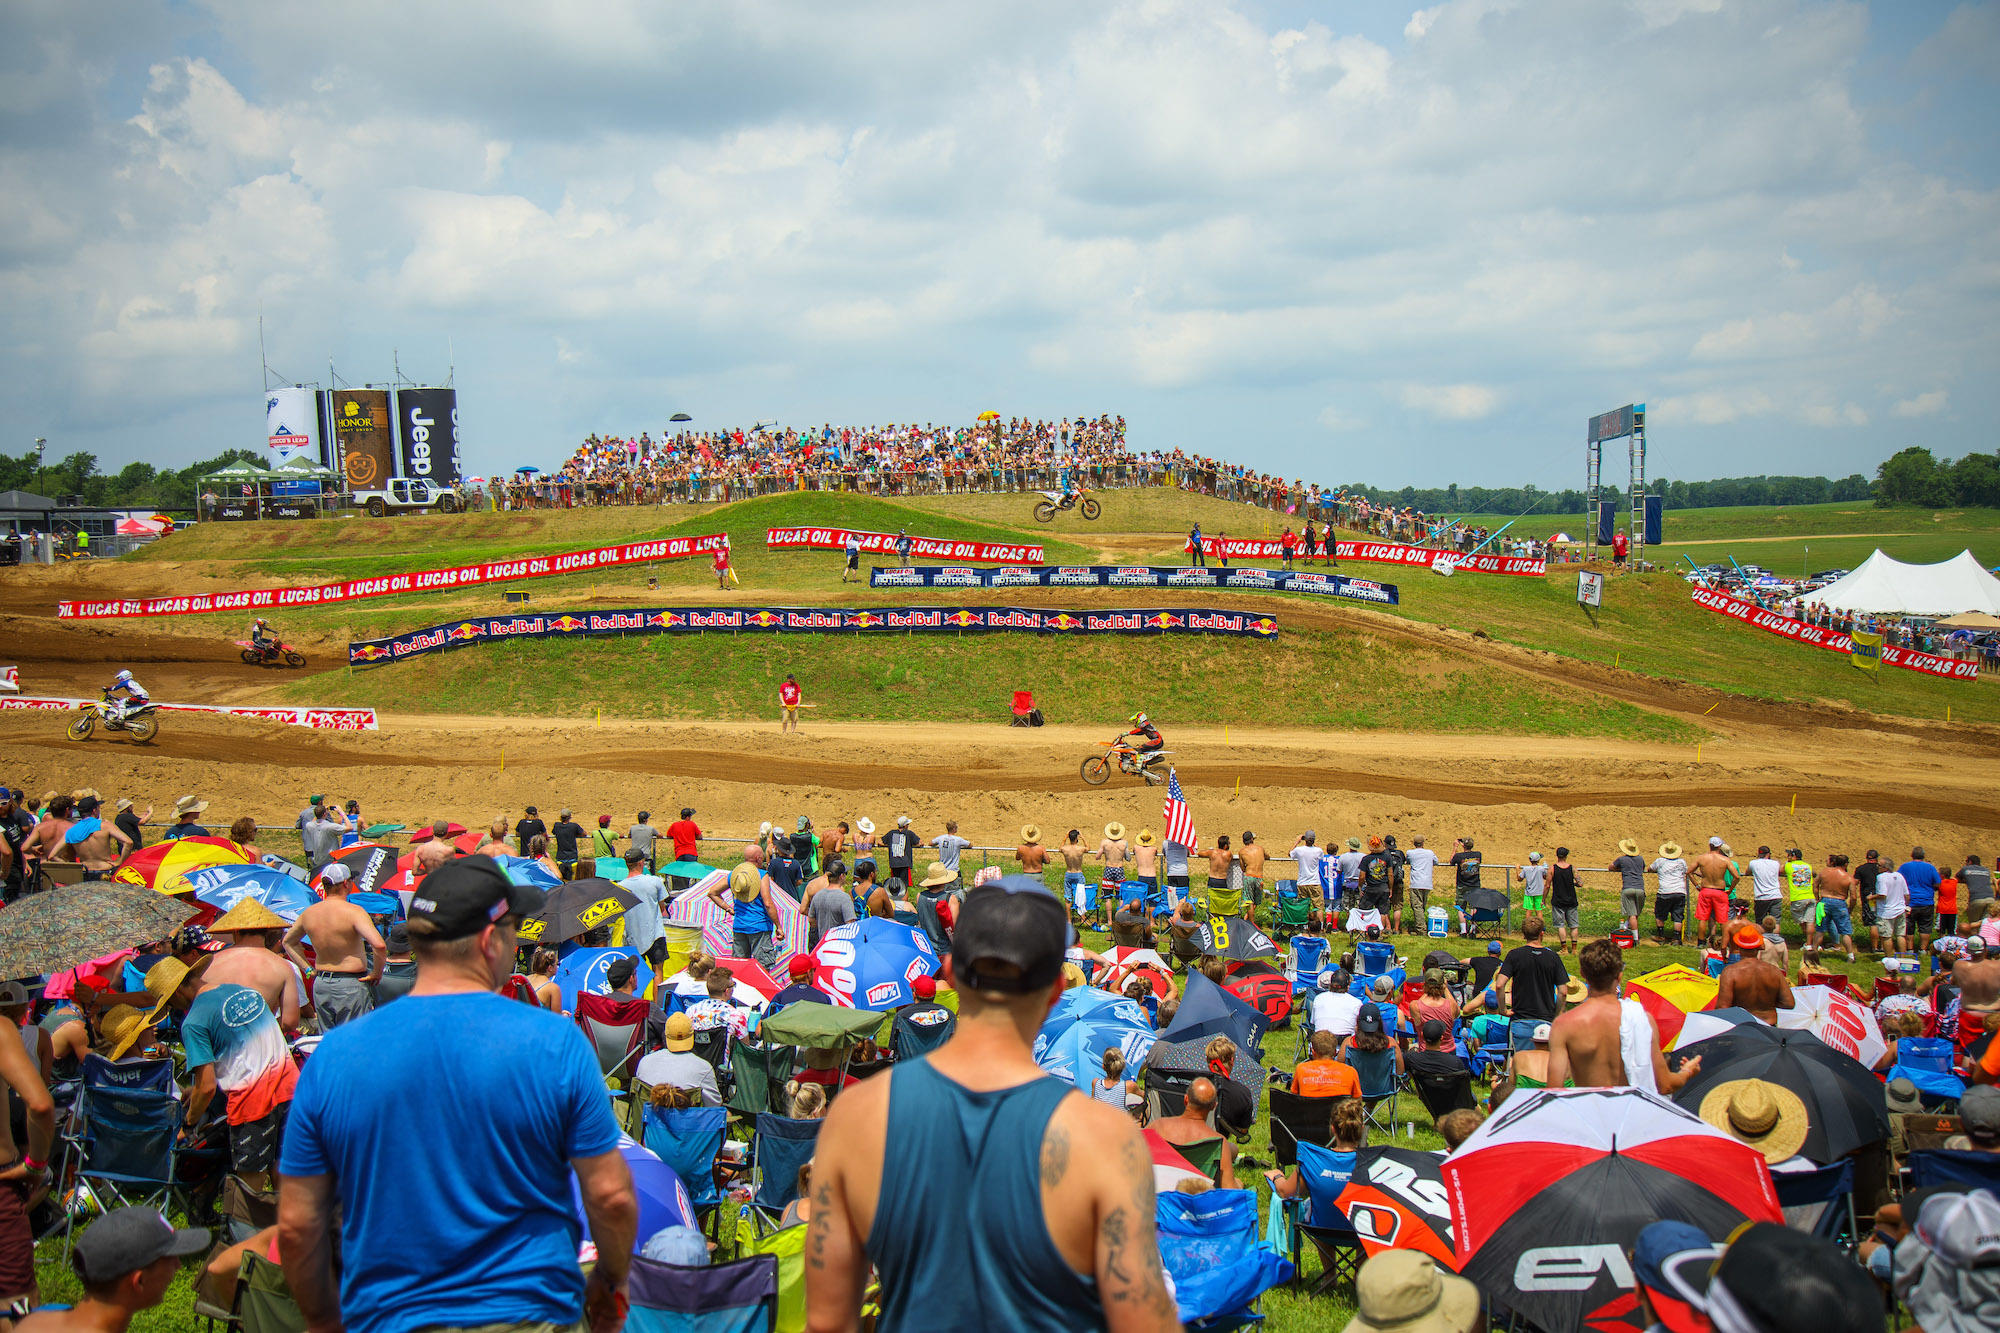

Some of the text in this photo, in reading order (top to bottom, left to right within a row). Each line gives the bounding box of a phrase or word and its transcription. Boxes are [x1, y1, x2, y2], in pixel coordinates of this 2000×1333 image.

[338, 418, 373, 428] HONOR
[411, 408, 435, 476] Jeep
[222, 508, 244, 518] Jeep
[279, 508, 300, 517] Jeep
[767, 529, 809, 544] LUCAS
[811, 529, 832, 544] OIL
[955, 543, 976, 558] OIL
[981, 546, 1025, 562] LUCAS
[1336, 544, 1356, 557] OIL
[1361, 545, 1404, 561] LUCAS
[1406, 549, 1427, 563] OIL
[1478, 558, 1499, 571] OIL
[1505, 560, 1545, 574] LUCAS
[79, 602, 120, 617] LUCAS
[122, 602, 143, 614] OIL
[148, 599, 190, 613] LUCAS
[192, 597, 213, 610] OIL
[252, 592, 274, 605] OIL
[279, 588, 321, 604] LUCAS
[324, 585, 344, 599] OIL
[349, 579, 389, 597] LUCAS
[391, 576, 412, 590] OIL
[416, 570, 457, 588] LUCAS
[460, 568, 481, 582] OIL
[486, 562, 527, 579] LUCAS
[529, 559, 550, 574] OIL
[555, 552, 597, 571] LUCAS
[599, 549, 620, 563] OIL
[625, 542, 667, 560] LUCAS
[669, 540, 691, 554] OIL
[875, 576, 924, 584] MOTOCROSS
[934, 576, 982, 584] MOTOCROSS
[992, 576, 1040, 584] MOTOCROSS
[1050, 575, 1099, 583] MOTOCROSS
[1109, 575, 1158, 584] MOTOCROSS
[1226, 577, 1276, 587] MOTOCROSS
[1285, 582, 1335, 593] MOTOCROSS
[1339, 588, 1390, 598] MOTOCROSS
[1727, 602, 1751, 619] OIL
[1753, 611, 1801, 635] LUCAS
[1800, 626, 1825, 643] OIL
[1904, 653, 1954, 674] LUCAS
[1955, 662, 1979, 677] OIL
[1851, 641, 1879, 659] SUZUKI
[869, 985, 897, 1003] 100%
